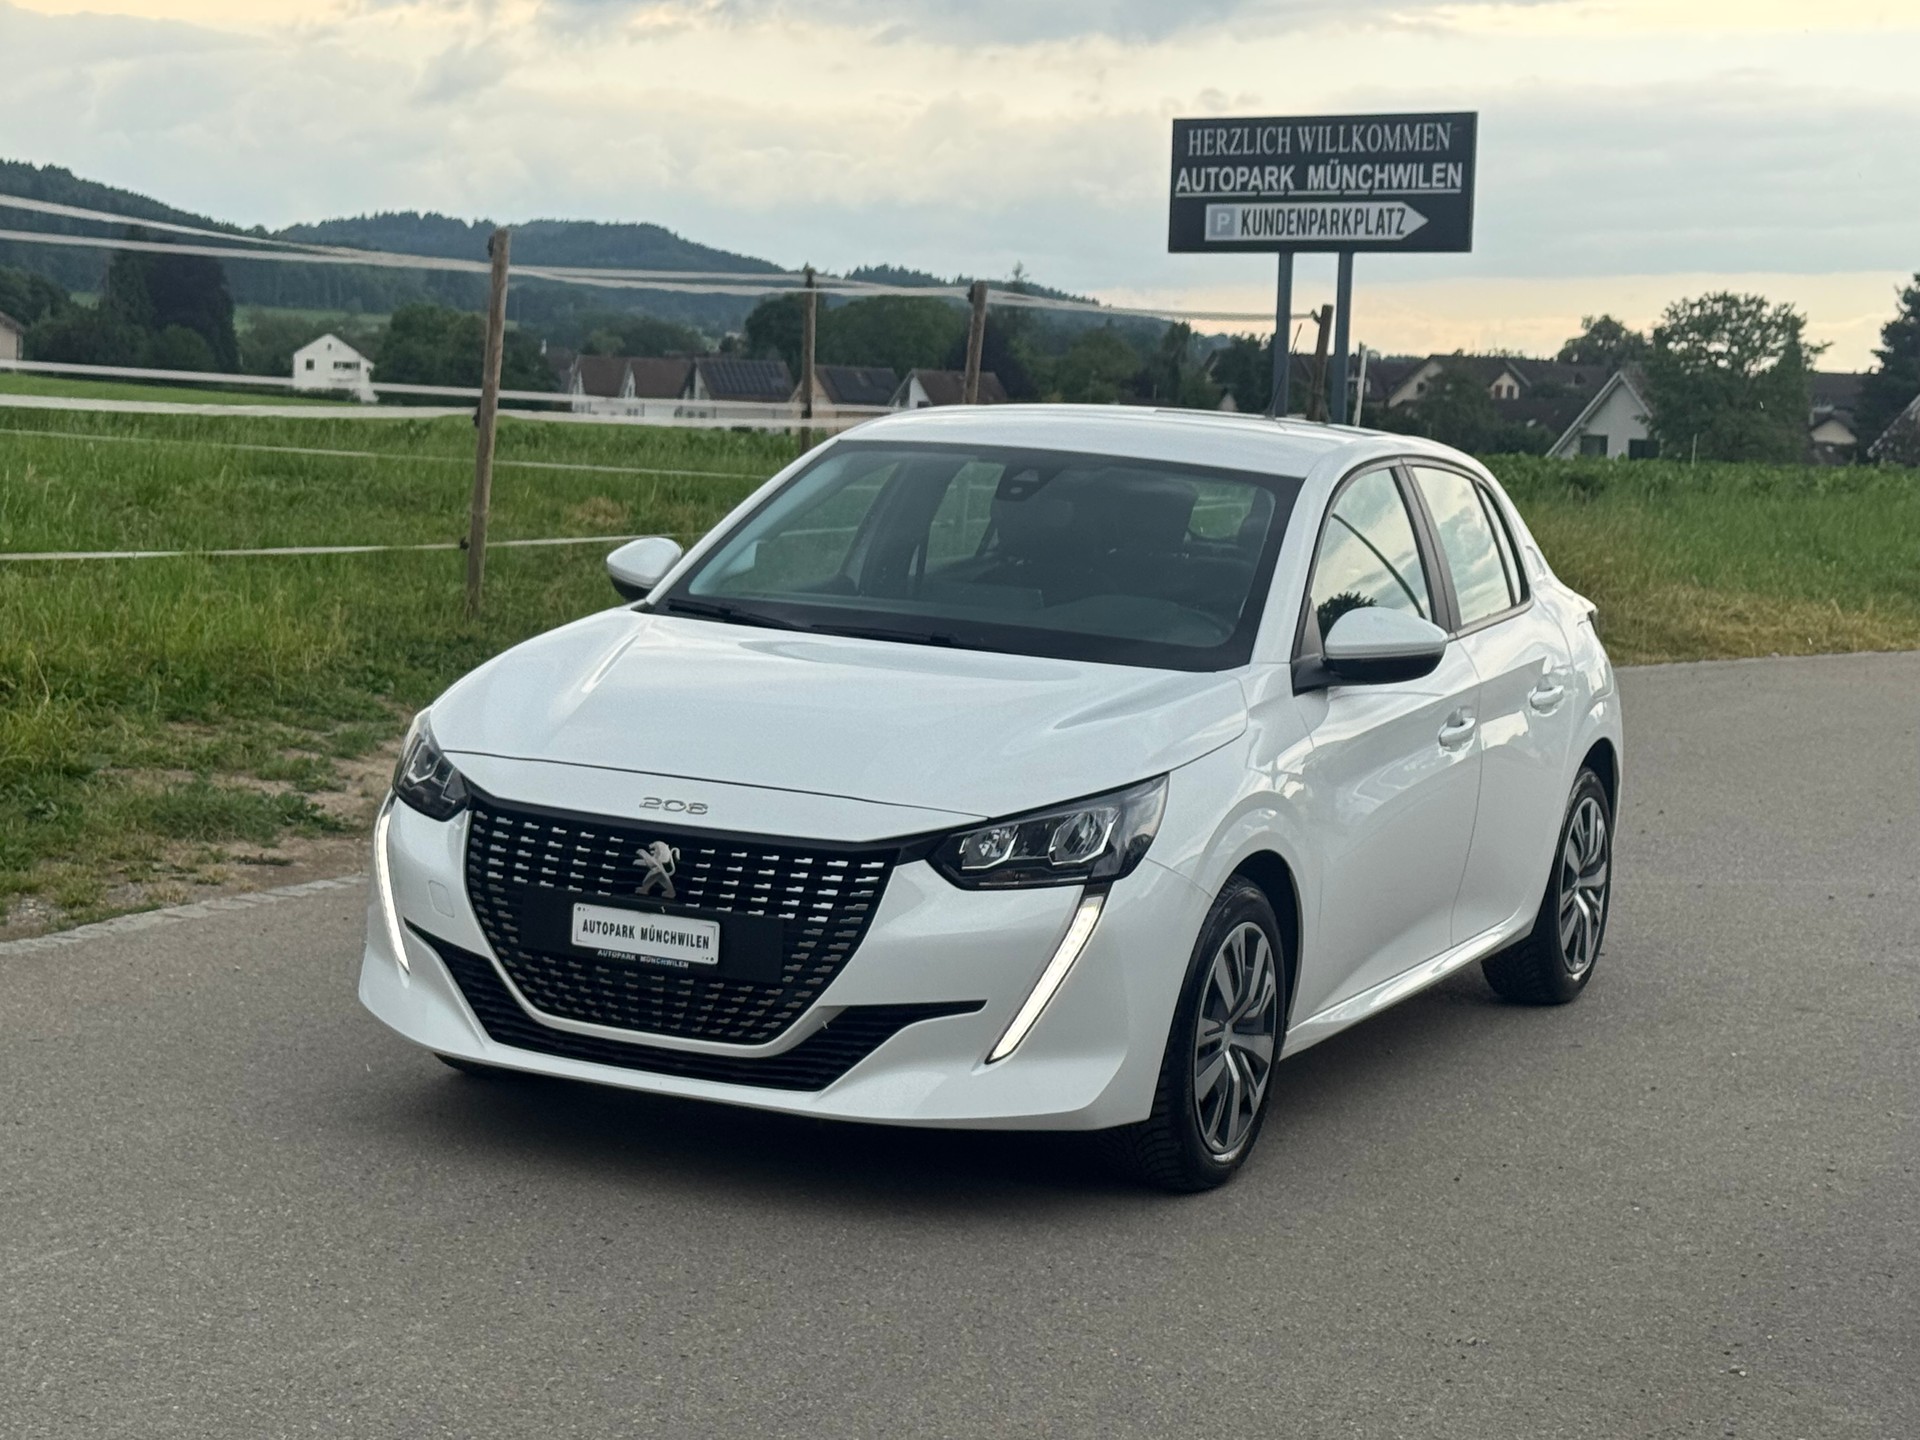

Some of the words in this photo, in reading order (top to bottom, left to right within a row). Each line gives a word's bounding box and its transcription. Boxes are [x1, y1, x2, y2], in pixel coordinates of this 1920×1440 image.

[1187, 125, 1292, 156] HERZLICH
[1297, 122, 1451, 153] WILLKOMMEN
[1175, 164, 1295, 192] AUTOPARK
[1307, 159, 1463, 190] MÜNCHWILEN
[1216, 212, 1231, 230] P
[1240, 207, 1407, 236] KUNDENPARKPLATZ
[639, 797, 709, 815] 208
[582, 919, 635, 940] AUTOPARK
[640, 924, 709, 950] MÜNCHWILEN
[597, 949, 636, 961] AUTOPARK
[640, 955, 689, 969] MÜNCHWILEN
